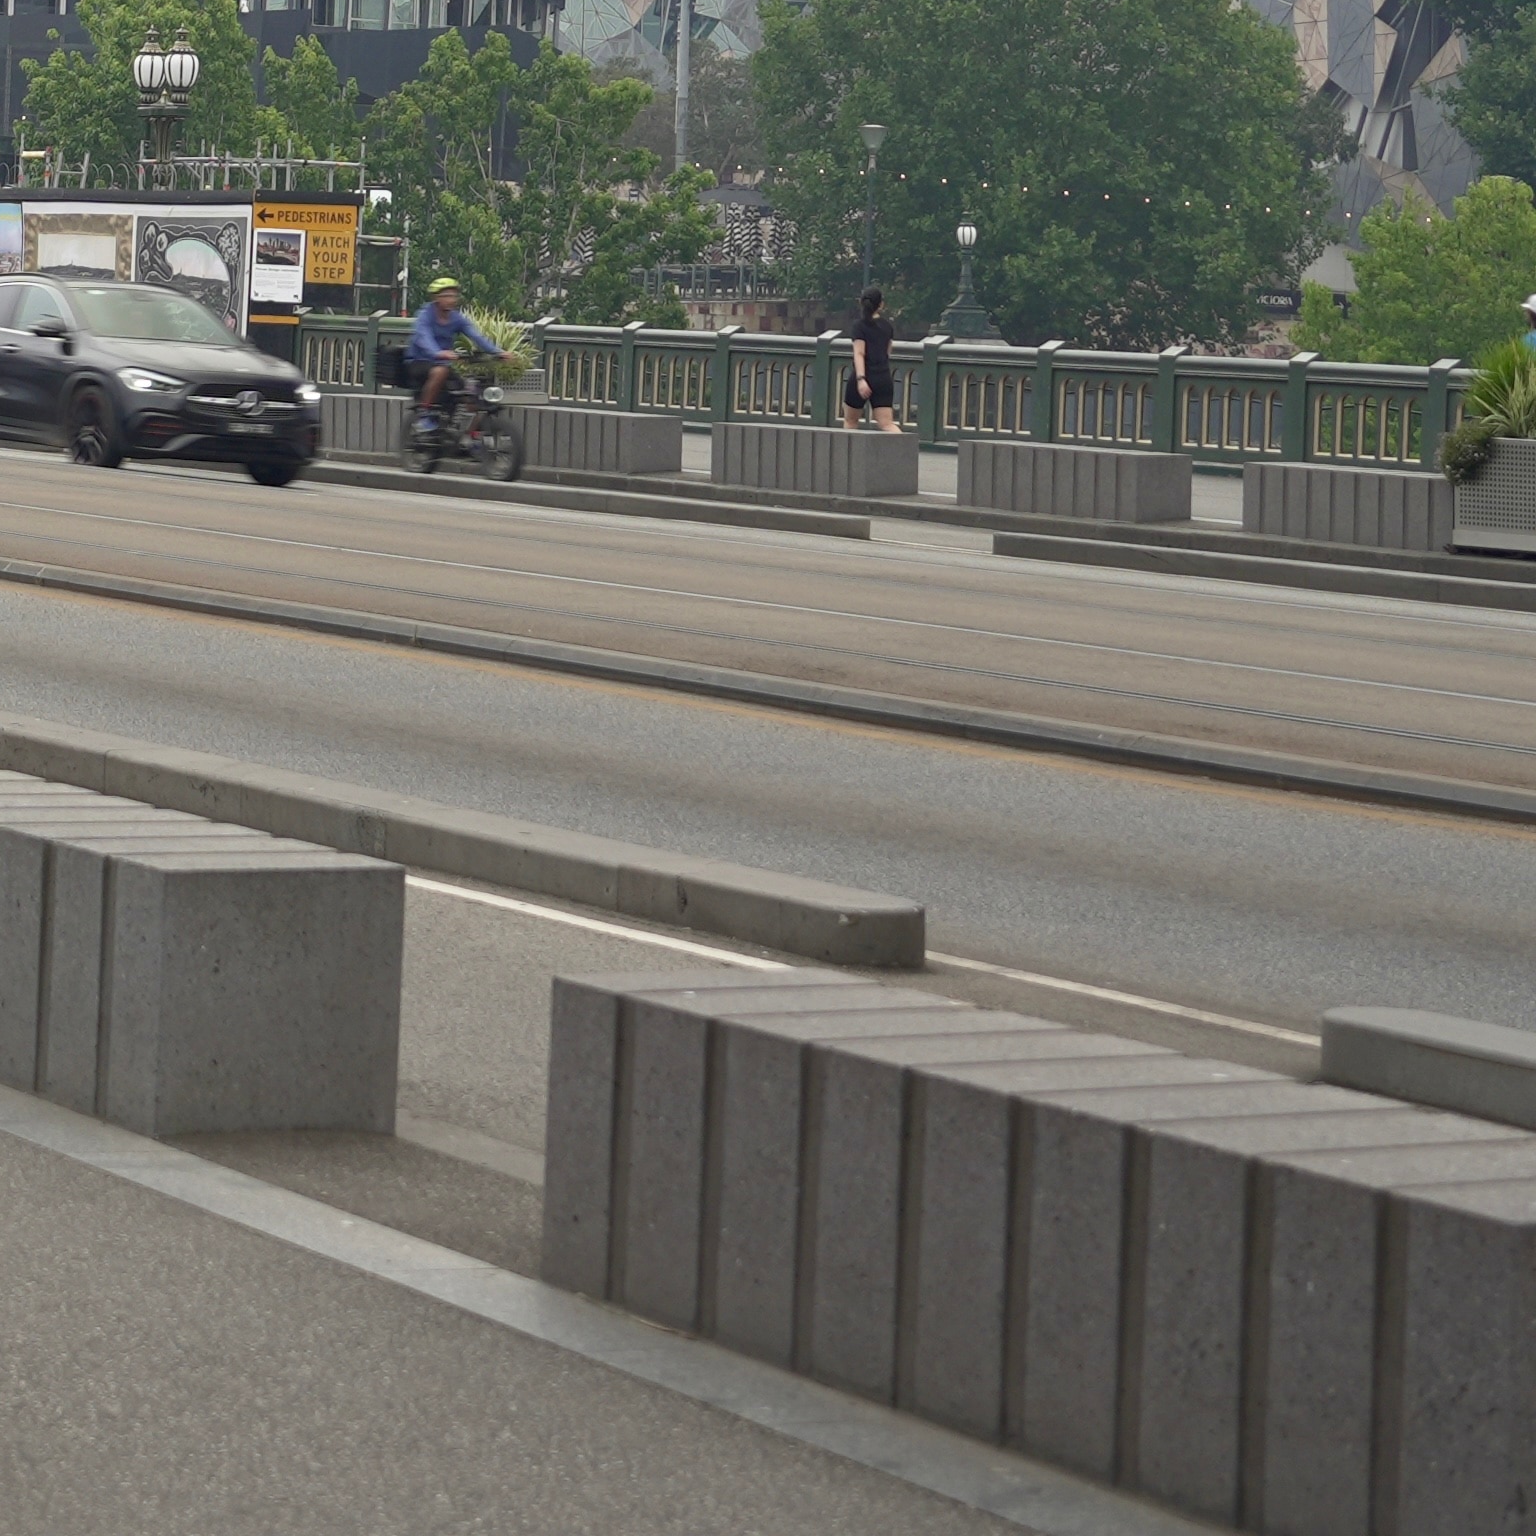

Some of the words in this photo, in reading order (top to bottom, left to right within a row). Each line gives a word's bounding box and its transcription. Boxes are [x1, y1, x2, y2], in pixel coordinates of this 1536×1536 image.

[277, 210, 352, 224] PEDESTRIANS
[312, 235, 350, 249] WATCH
[312, 251, 348, 264] YOUR
[313, 267, 346, 279] STEP
